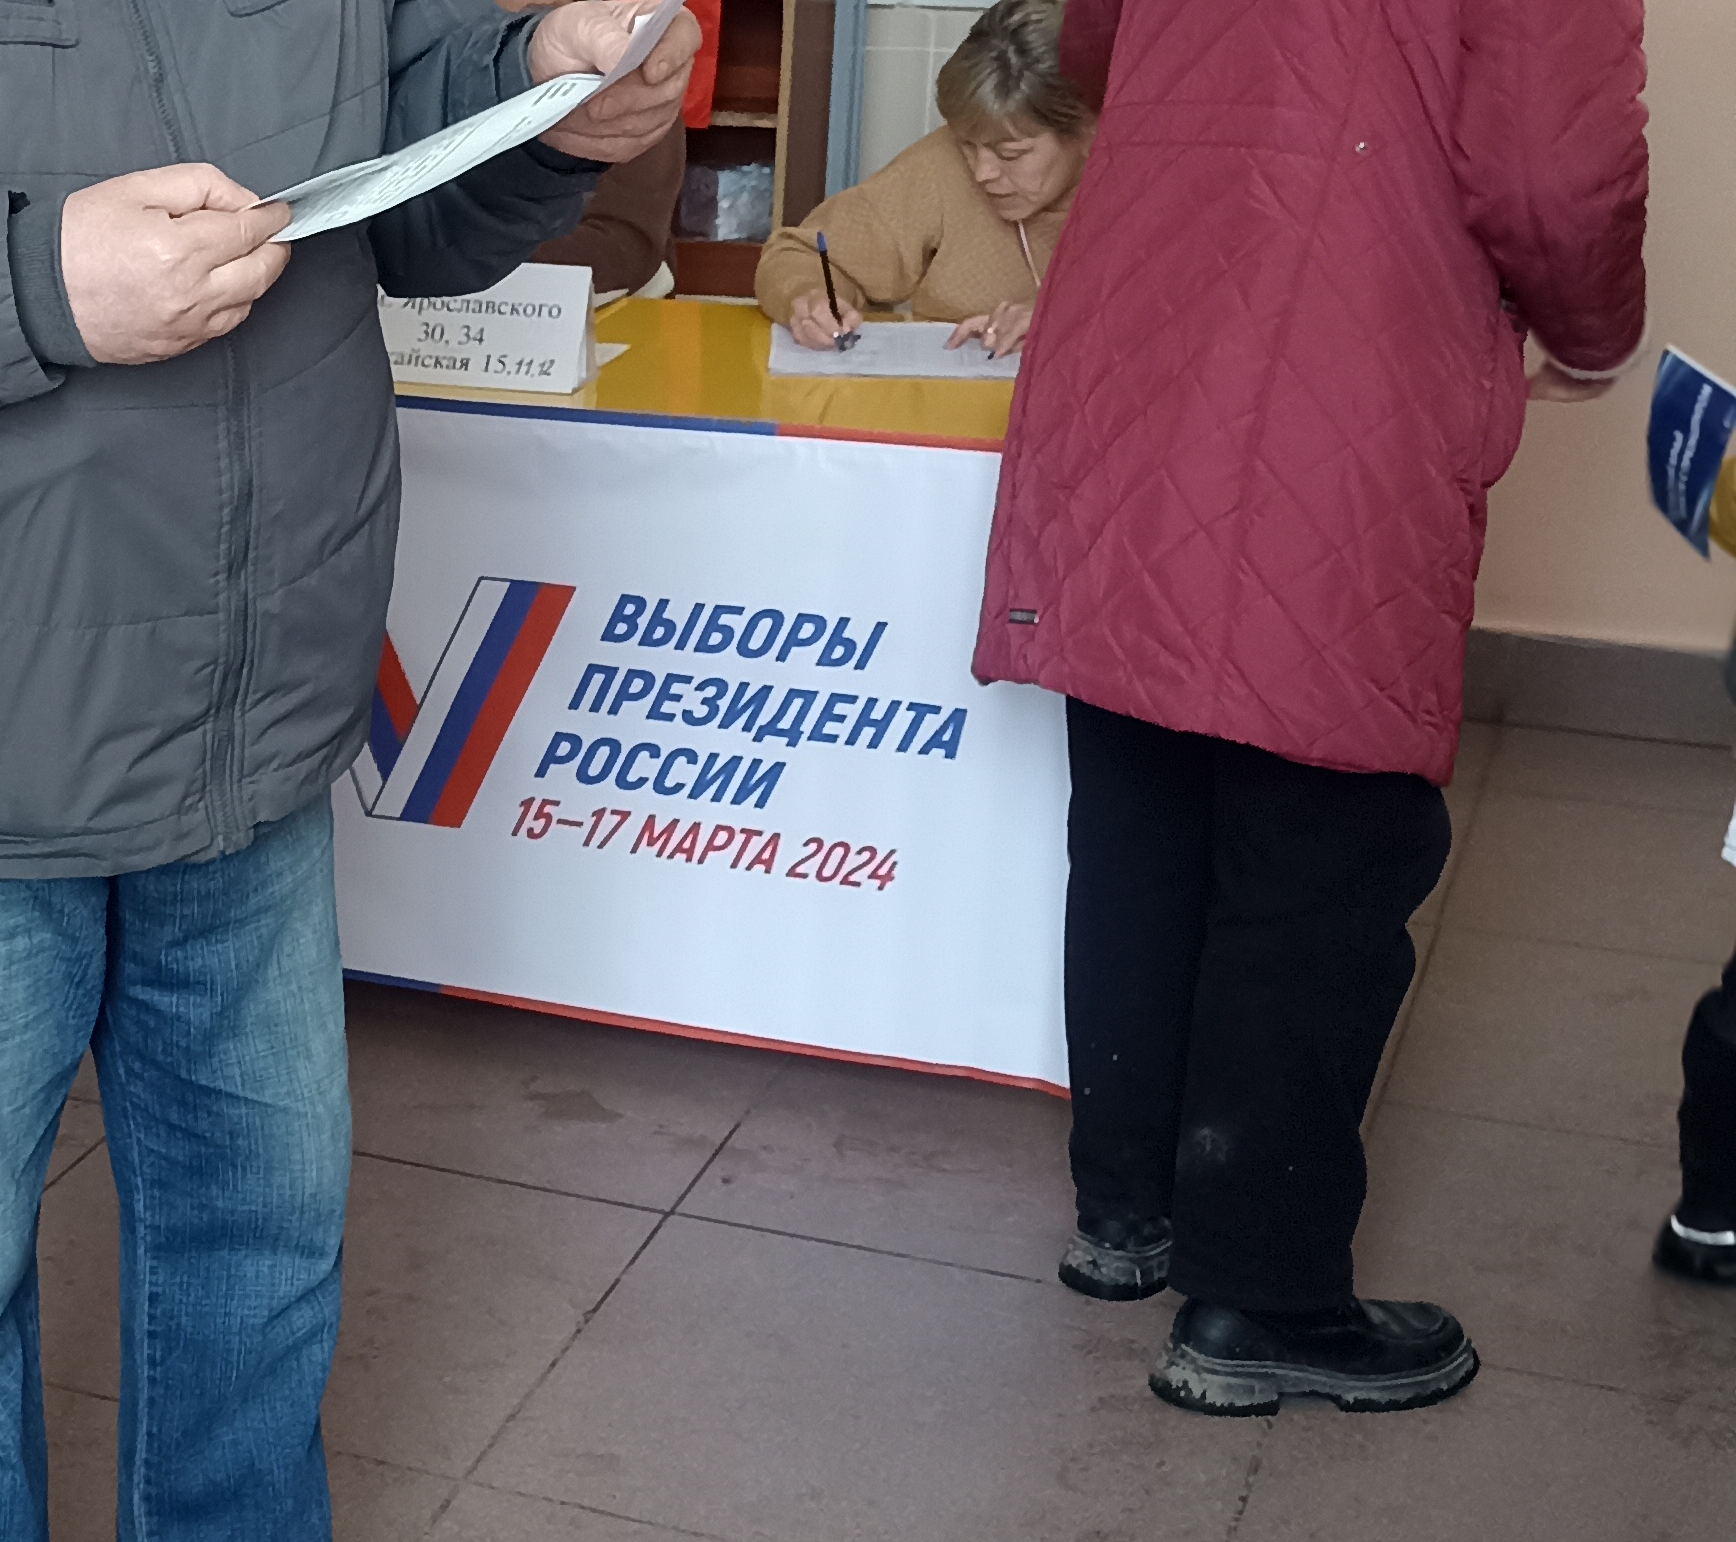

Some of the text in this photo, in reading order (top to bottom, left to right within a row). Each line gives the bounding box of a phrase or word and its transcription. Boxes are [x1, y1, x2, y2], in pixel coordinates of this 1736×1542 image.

[458, 325, 485, 346] 34
[599, 593, 888, 671] ВЫБОРЫ
[567, 662, 968, 760] ПРЕЗИДЕНТА
[534, 731, 786, 810] РОССИИ
[630, 813, 781, 873] МАРТА
[786, 837, 900, 892] 2024
